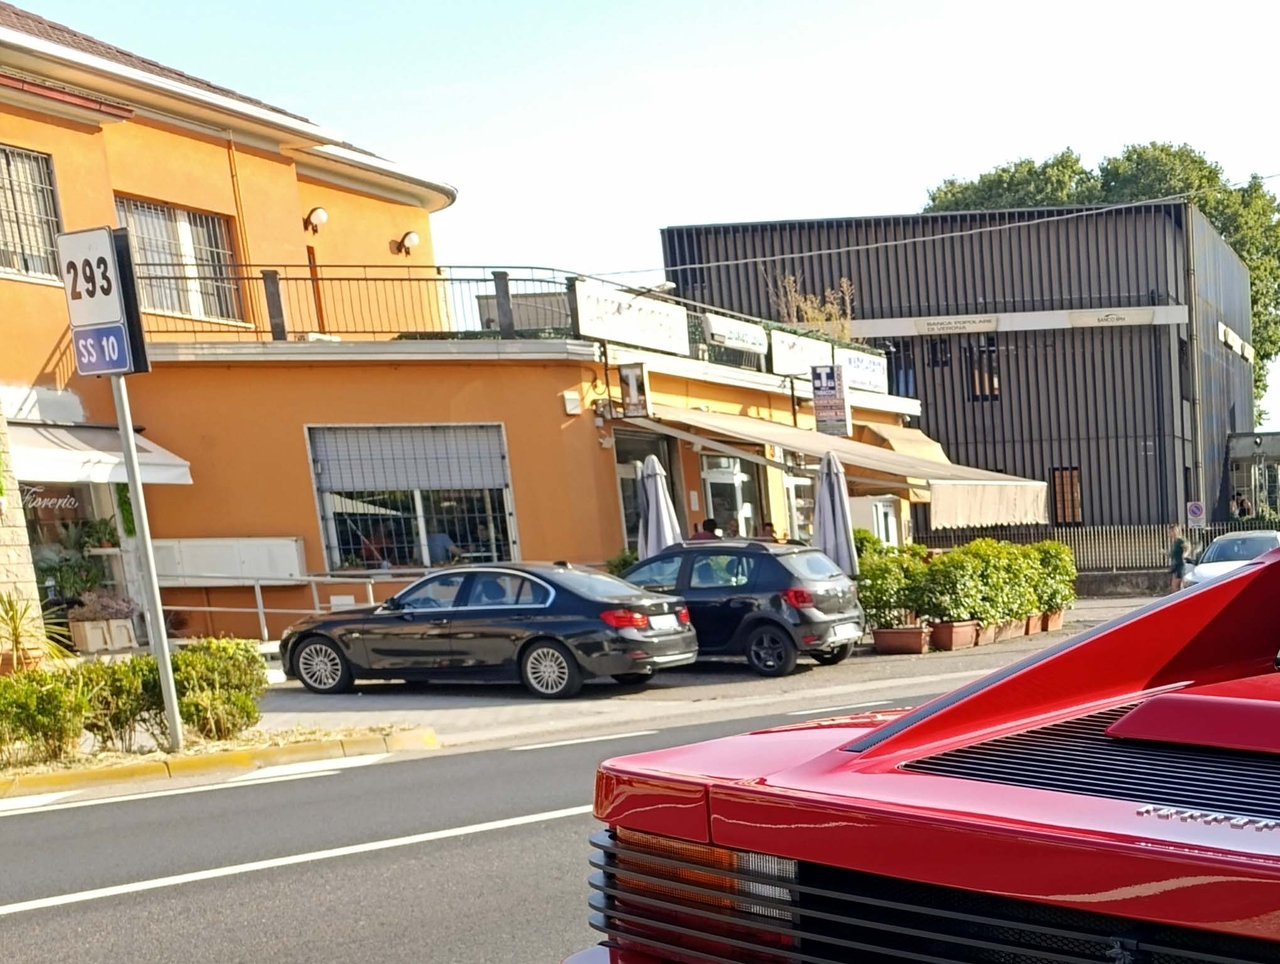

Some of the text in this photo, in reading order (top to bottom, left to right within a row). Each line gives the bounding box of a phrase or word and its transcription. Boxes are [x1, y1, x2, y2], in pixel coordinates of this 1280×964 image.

[66, 256, 112, 300] 293
[953, 318, 992, 326] POPOLARE
[79, 335, 119, 363] SS 10
